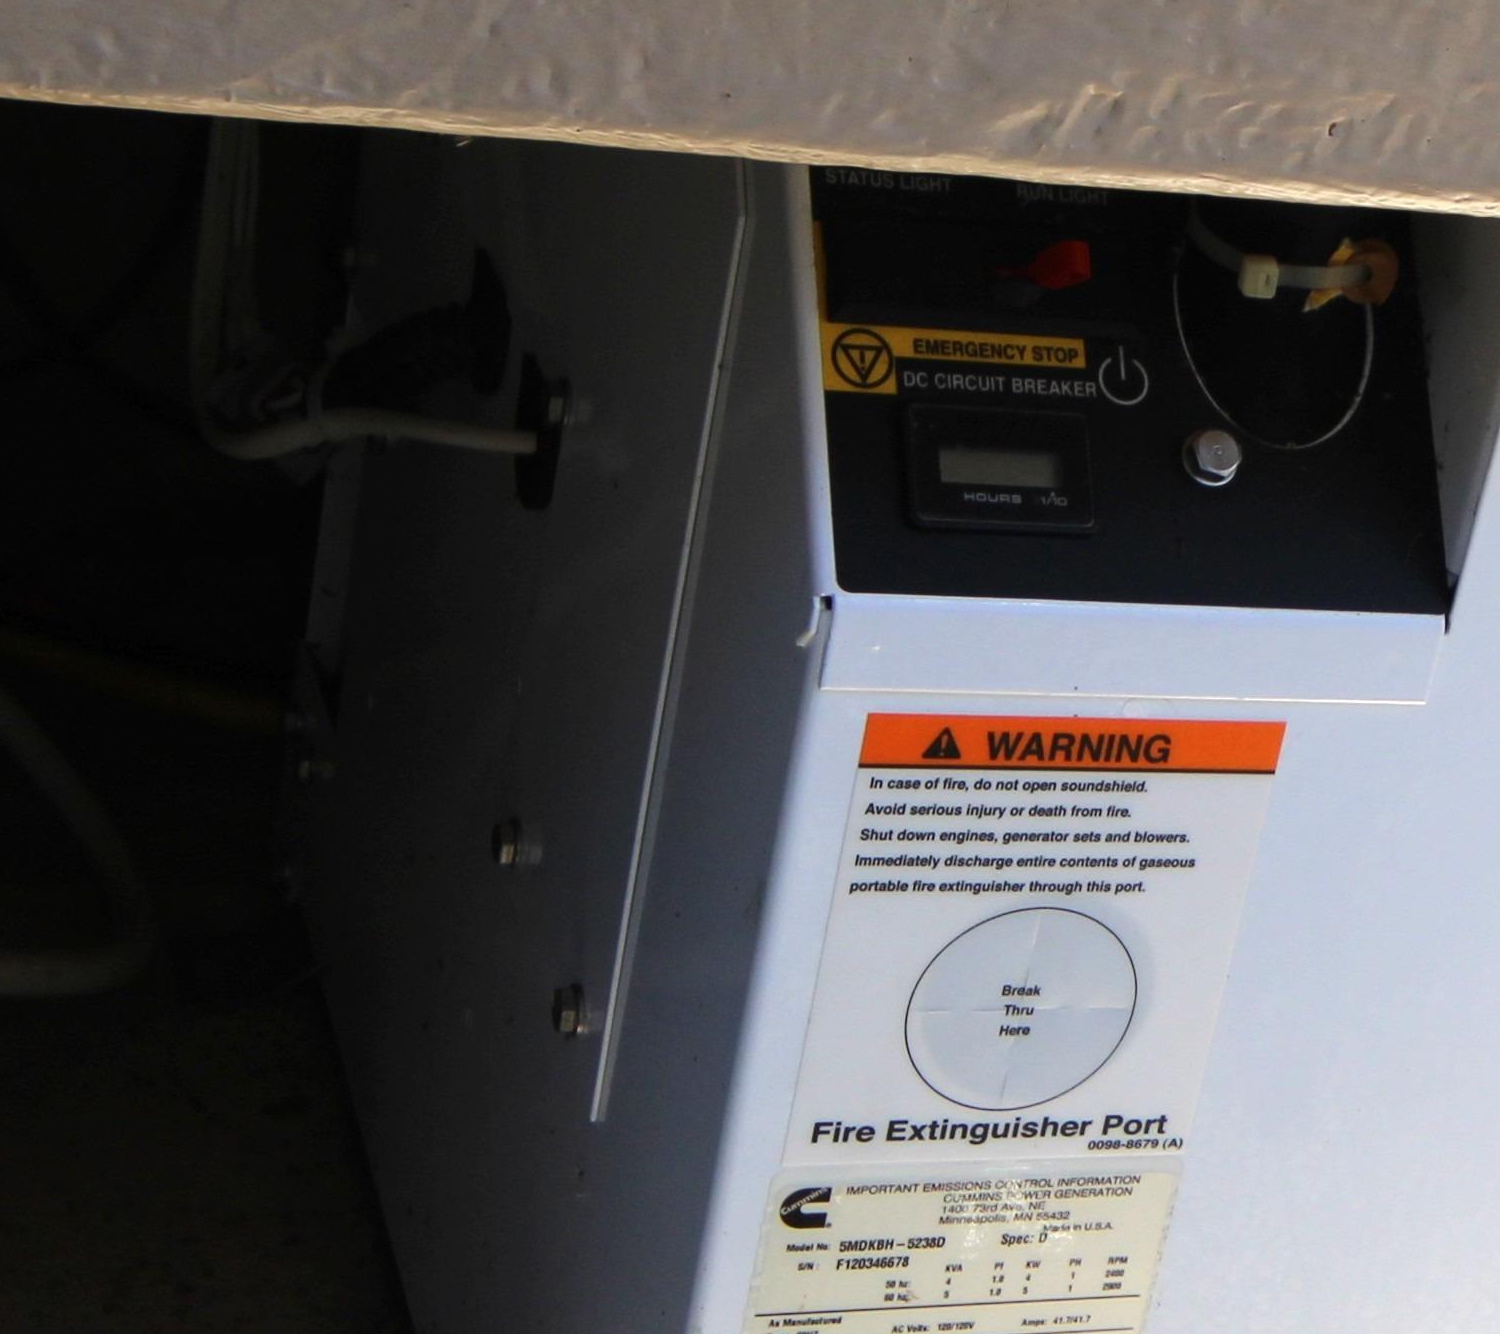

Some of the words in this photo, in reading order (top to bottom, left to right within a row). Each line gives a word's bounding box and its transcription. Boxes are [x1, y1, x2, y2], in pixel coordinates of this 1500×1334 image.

[825, 169, 894, 188] STATUS
[899, 174, 951, 191] LIGHT
[1058, 186, 1110, 203] LIGHT
[912, 338, 1026, 360] EMERGENCY
[1031, 346, 1079, 364] STOP
[903, 370, 927, 387] DC
[934, 372, 1004, 391] CIRCUIT
[1011, 377, 1097, 396] BREAKER
[963, 492, 1022, 504] HOURS
[986, 731, 1171, 763] WARNING
[869, 776, 883, 789] In
[886, 779, 921, 789] case
[924, 777, 939, 789] of
[942, 777, 968, 791] fire,
[973, 778, 991, 790] do
[995, 779, 1019, 790] not
[1022, 781, 1056, 793] open
[1060, 780, 1147, 792] soundshield.
[864, 802, 906, 815] Avoid
[909, 803, 962, 815] serious
[965, 803, 1006, 819] injury
[1009, 806, 1025, 816] or
[1028, 804, 1066, 816] death
[1070, 805, 1102, 817] from
[1106, 805, 1130, 817] fire.
[859, 828, 893, 841] Shut
[896, 828, 935, 841] down
[939, 829, 997, 844] engines,
[1002, 831, 1069, 844] generator
[1072, 831, 1101, 842] sets
[1104, 831, 1131, 842] and
[1133, 831, 1189, 843] blowers.
[854, 854, 940, 869] Immediately
[943, 854, 1013, 870] discharge
[1016, 855, 1056, 867] entire
[1059, 856, 1118, 867] contents
[1122, 856, 1136, 867] of
[1139, 858, 1195, 870] gaseous
[848, 880, 908, 894] portable
[912, 879, 935, 891] fire
[938, 880, 1025, 895] extinguisher
[1028, 880, 1082, 895] through
[1086, 880, 1111, 892] this
[1114, 881, 1144, 895] port.
[1001, 985, 1041, 997] Break
[1003, 1005, 1035, 1017] Thru
[999, 1025, 1031, 1037] Here
[810, 1121, 875, 1143] Fire
[885, 1116, 1092, 1144] Extinguisher
[1101, 1114, 1167, 1135] Port
[1087, 1139, 1159, 1151] 0098-8679
[1162, 1138, 1184, 1151] (A)
[845, 1182, 920, 1195] IMPORTANT
[922, 1180, 991, 1192] EMISSIONS
[1056, 1174, 1141, 1187] INFORMATION
[942, 1191, 1002, 1203] CUMMINS
[1053, 1186, 1133, 1199] GENERATION
[1028, 1200, 1045, 1210] NE
[1013, 1211, 1033, 1221] MN
[1035, 1210, 1070, 1220] 55432
[786, 1243, 813, 1251] Model
[838, 1238, 894, 1252] 5MDKBH
[907, 1236, 945, 1249] 5238D
[1000, 1233, 1033, 1247] Spec:
[1038, 1231, 1047, 1243] D
[835, 1255, 909, 1270] F120346678
